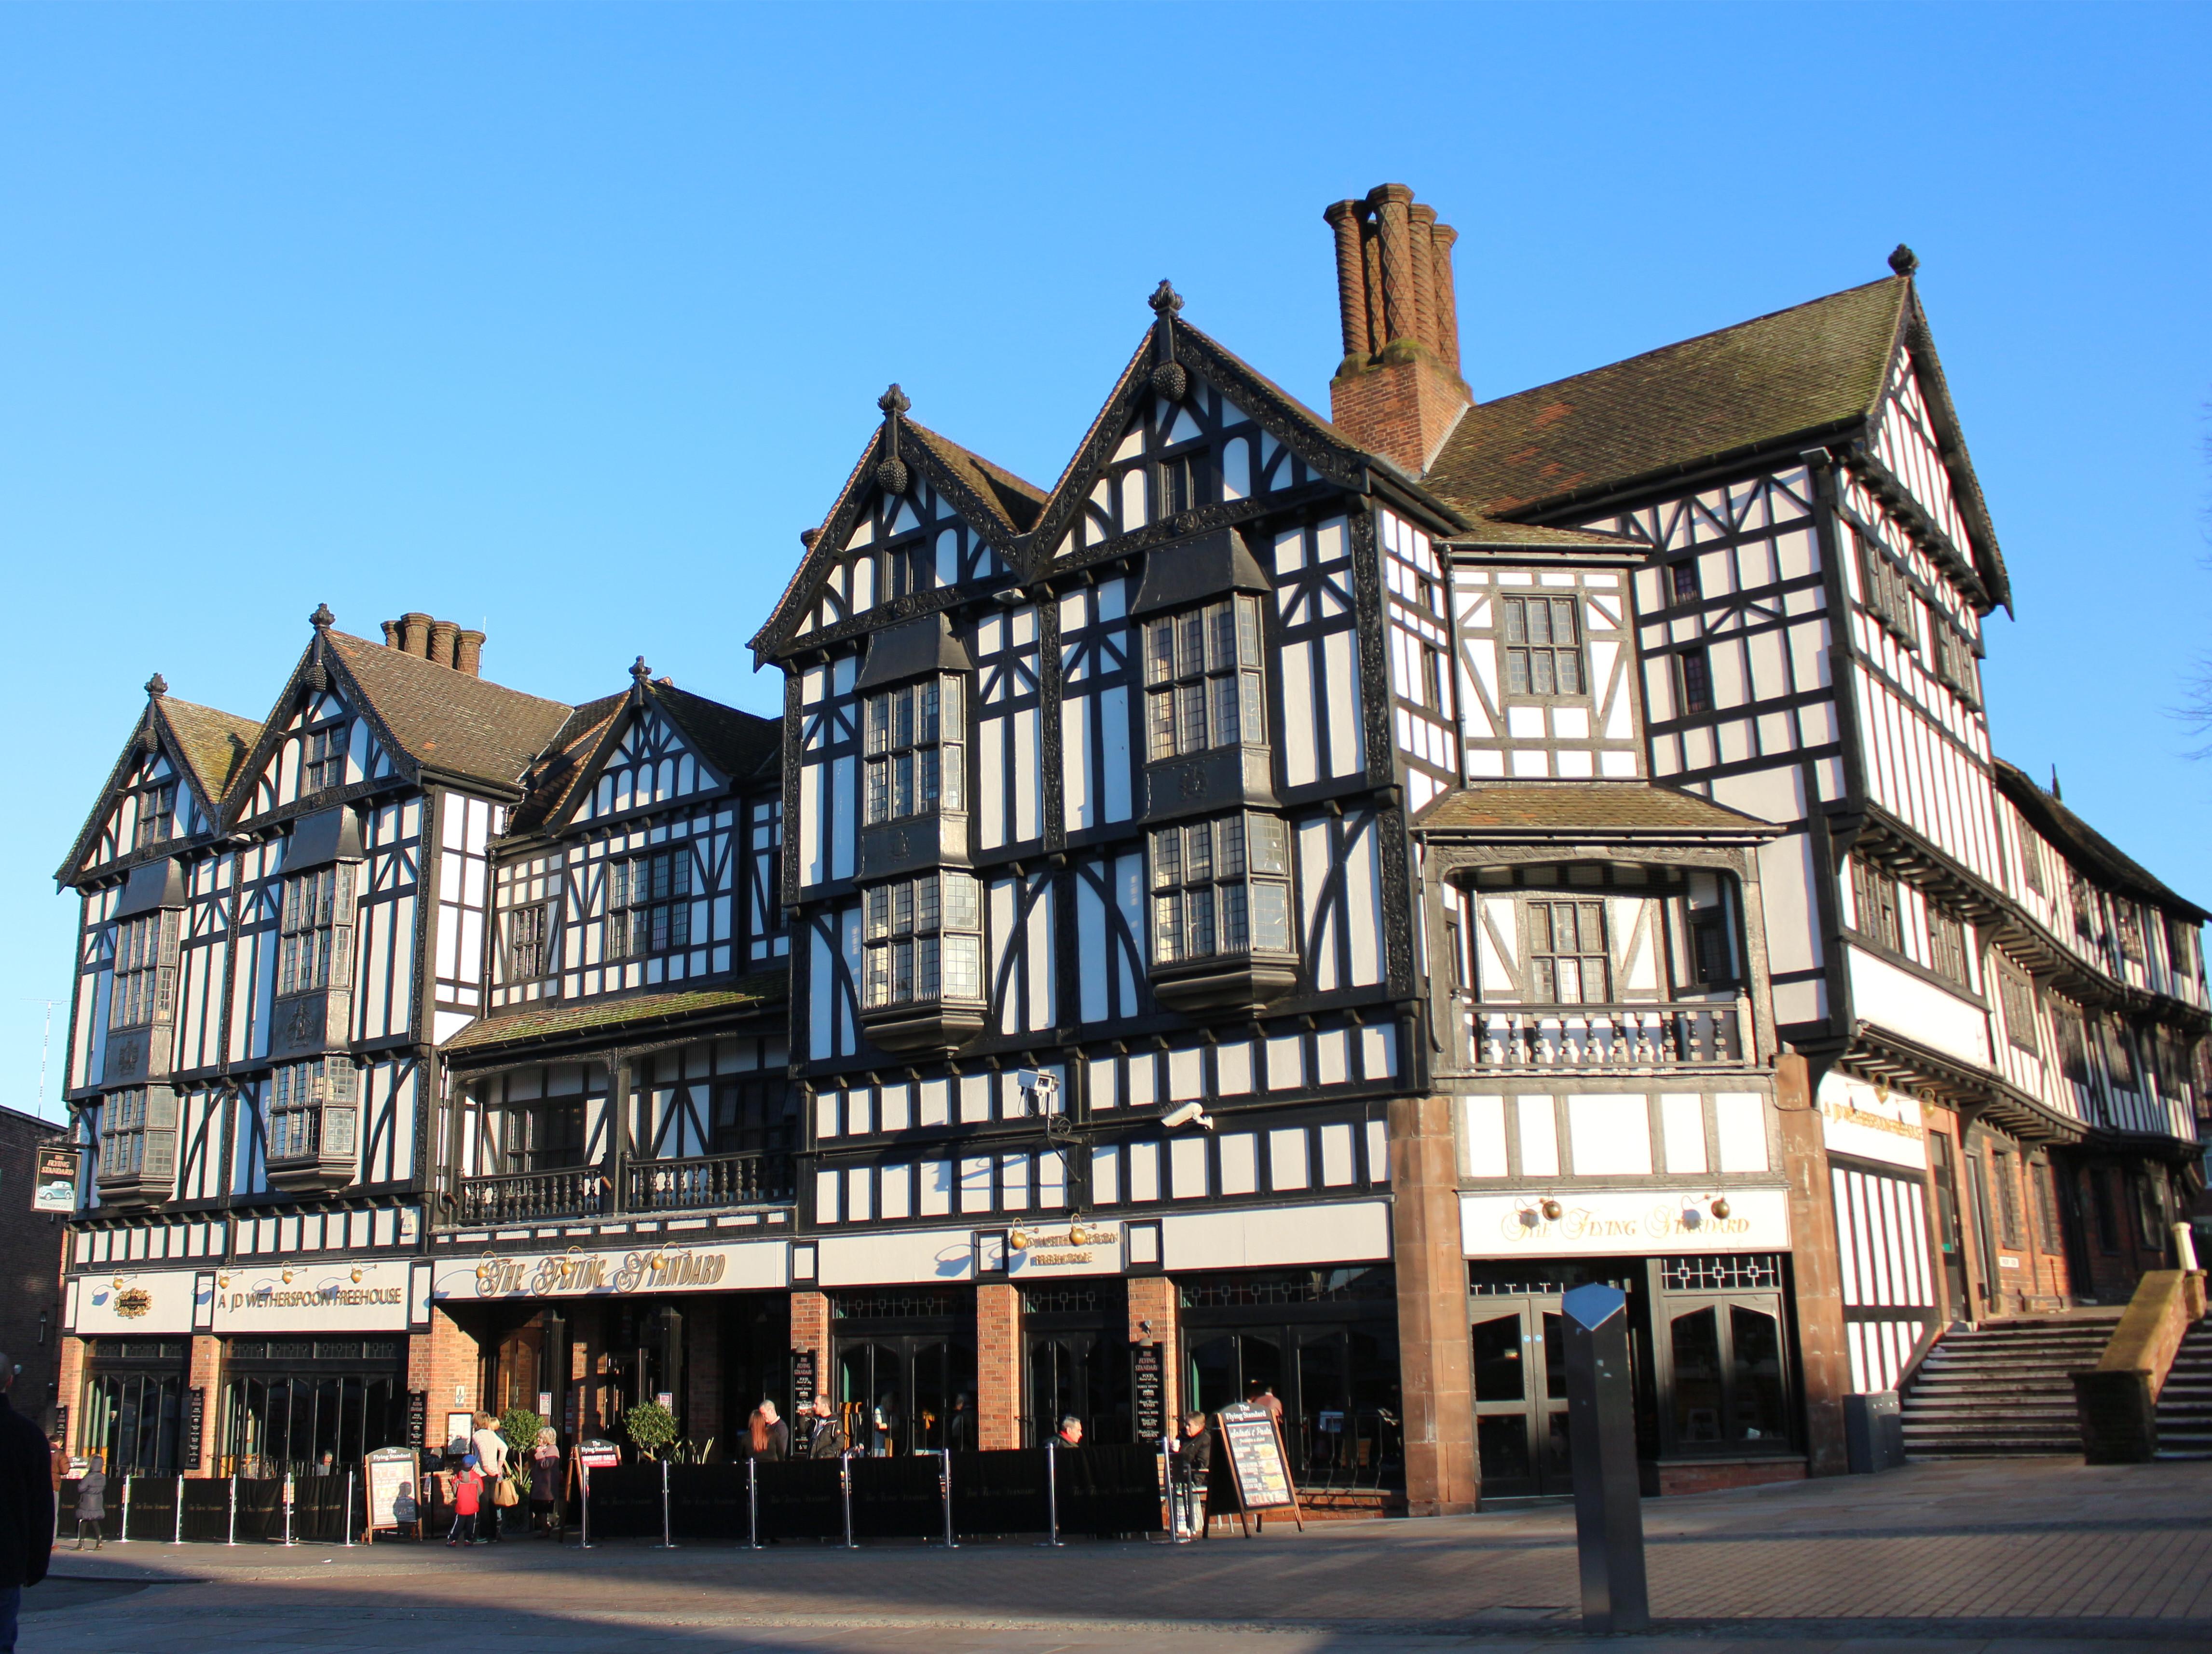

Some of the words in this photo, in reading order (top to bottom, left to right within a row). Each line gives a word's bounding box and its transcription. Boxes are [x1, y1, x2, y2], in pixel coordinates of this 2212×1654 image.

[47, 1160, 70, 1168] FLYING
[41, 1166, 74, 1176] STANDARD
[1501, 1208, 1552, 1241] THE
[1559, 1207, 1638, 1240] FLYING
[1644, 1205, 1750, 1238] STANDARD
[476, 1258, 526, 1297] THE
[531, 1256, 608, 1296] FLYING
[613, 1250, 725, 1293] STANDARD
[217, 1293, 226, 1309] A
[229, 1292, 244, 1313] JD
[246, 1290, 333, 1308] WETHERSPOON
[335, 1287, 402, 1305] FREEHOUSE
[1225, 1412, 1243, 1422] Flying
[1243, 1410, 1267, 1419] Standard
[1230, 1428, 1251, 1438] Salads
[1256, 1426, 1272, 1436] Pasta
